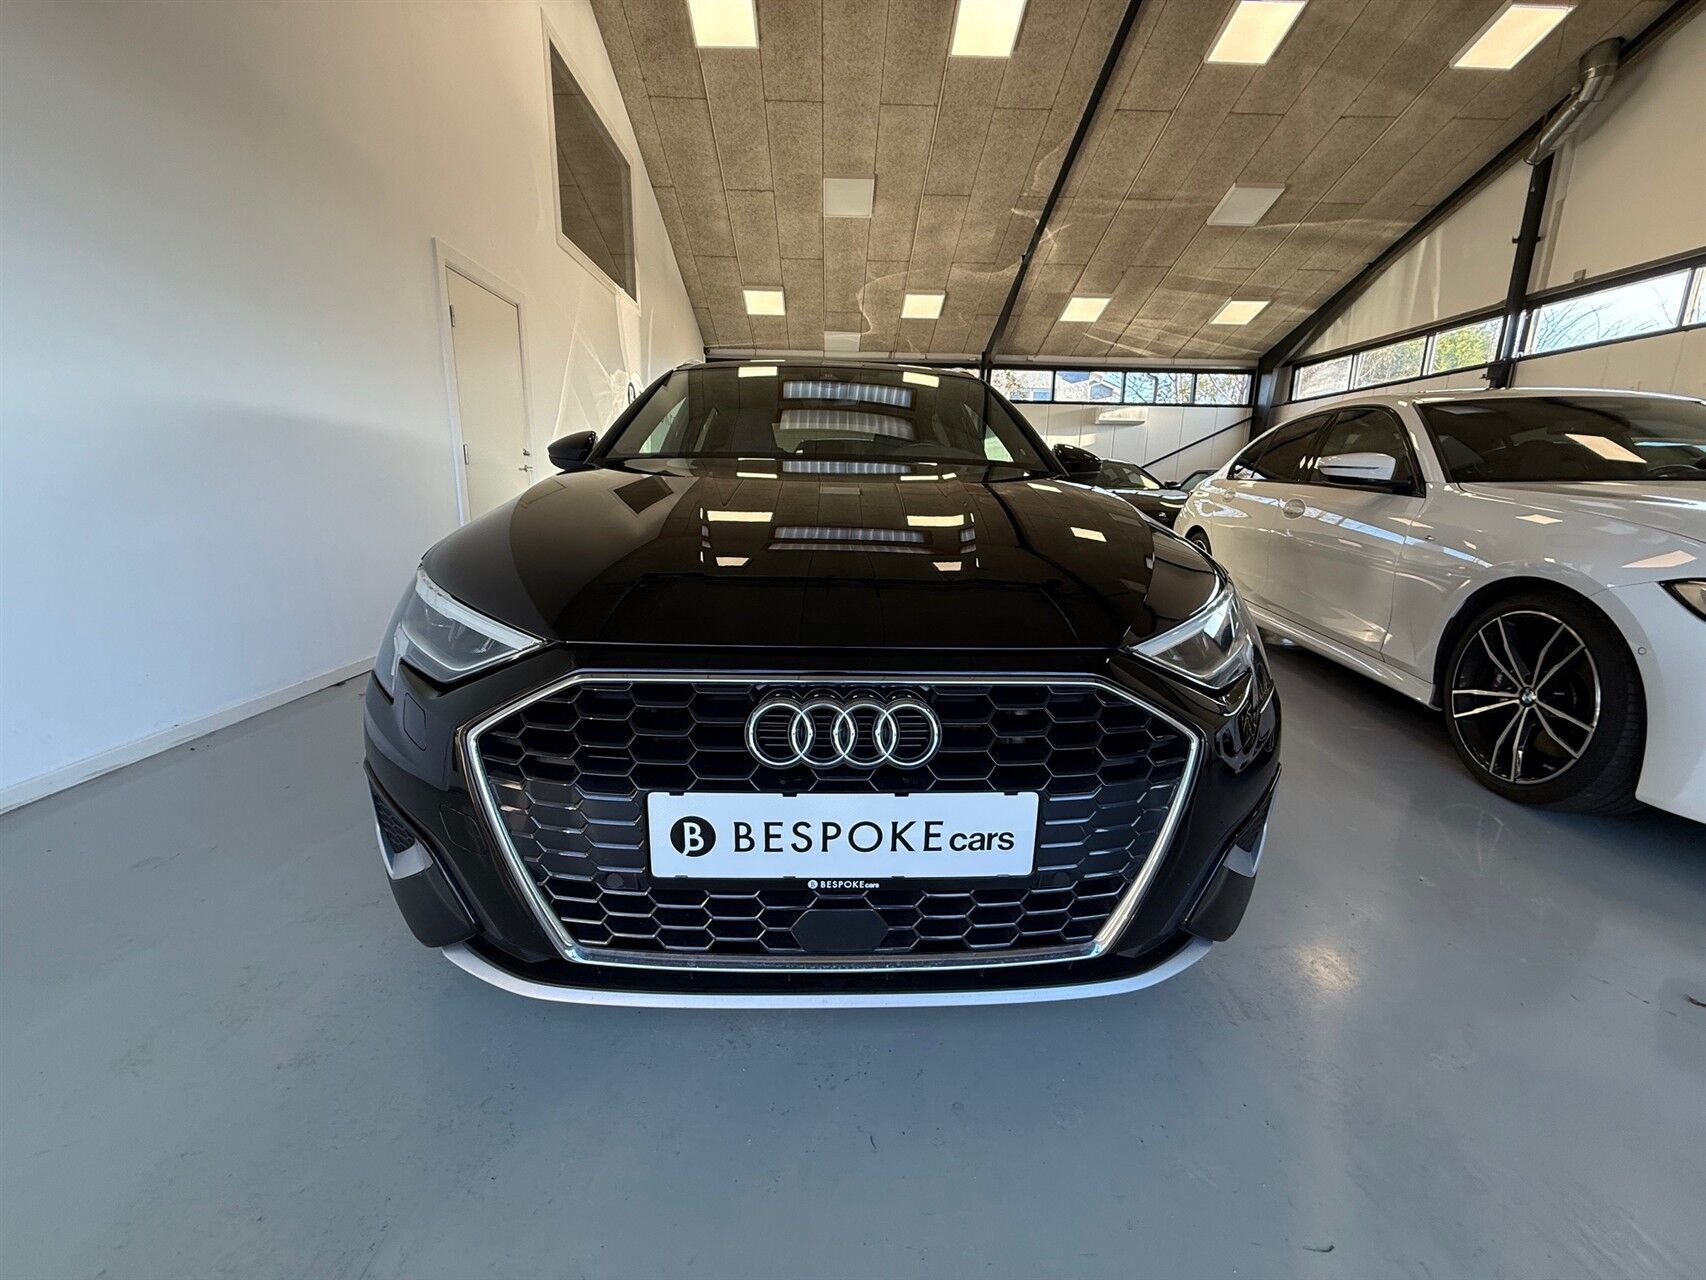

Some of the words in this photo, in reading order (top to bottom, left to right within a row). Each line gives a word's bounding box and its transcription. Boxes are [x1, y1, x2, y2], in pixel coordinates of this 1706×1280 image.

[733, 821, 944, 853] BESPOKE
[949, 831, 1015, 852] cars
[820, 880, 865, 889] BESPOKE
